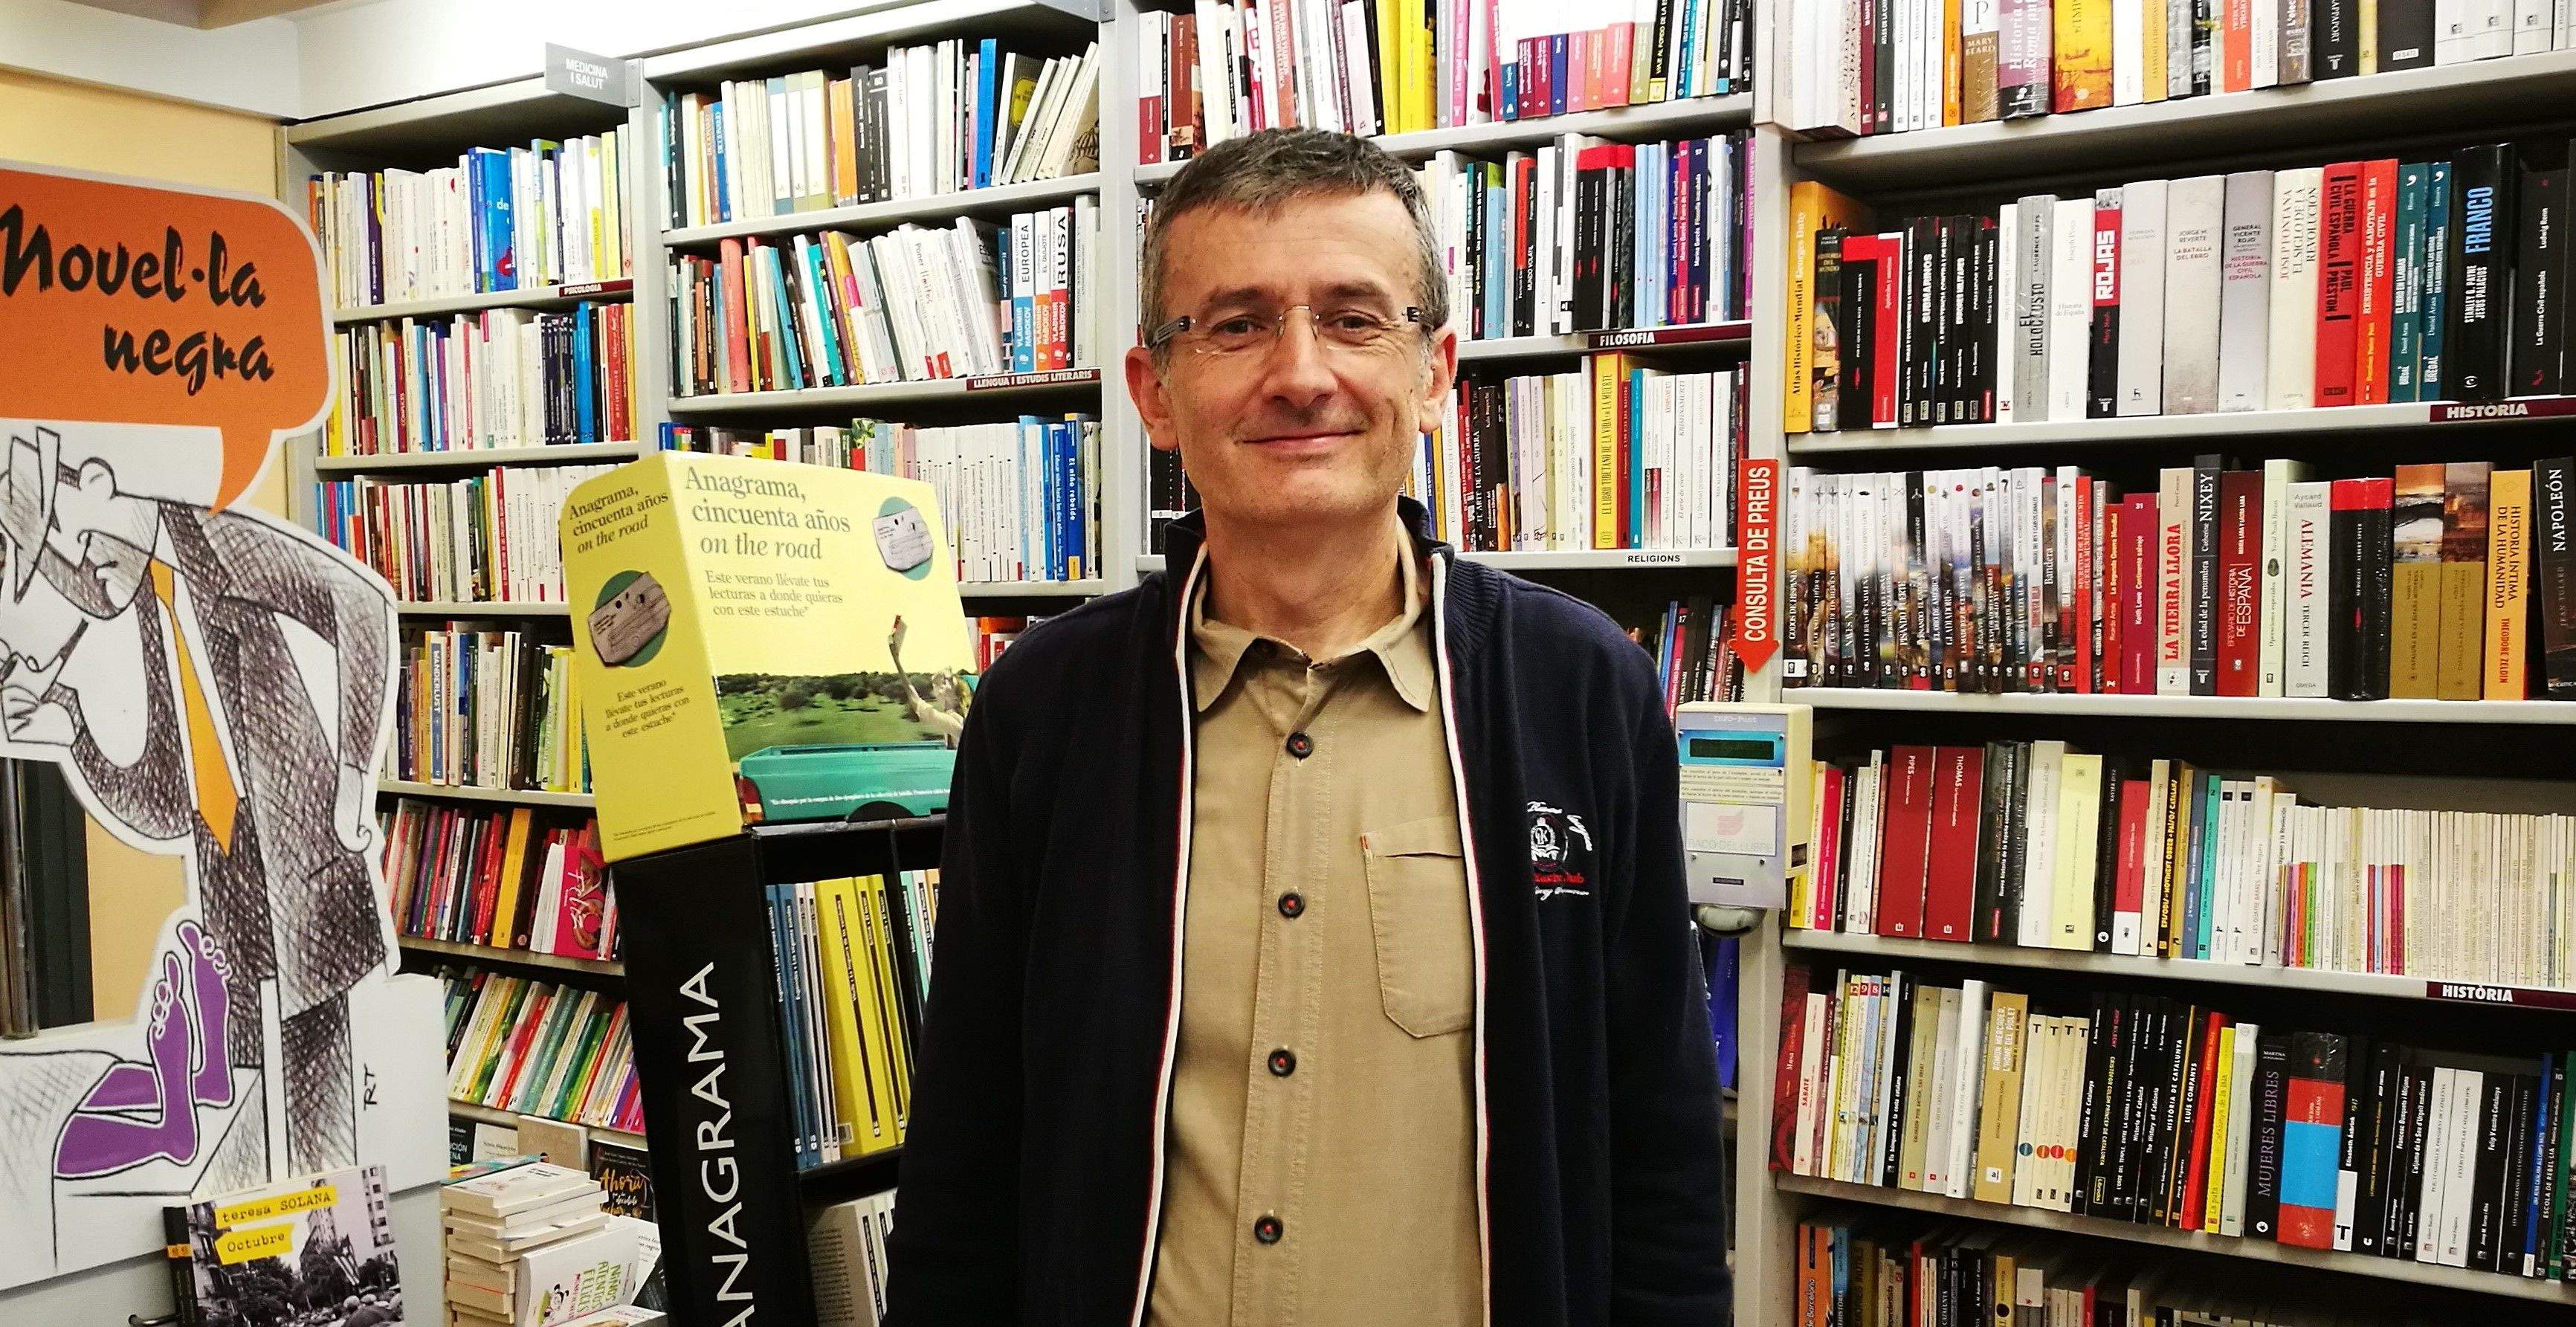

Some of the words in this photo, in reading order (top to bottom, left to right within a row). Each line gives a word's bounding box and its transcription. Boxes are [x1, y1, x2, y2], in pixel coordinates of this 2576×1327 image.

[1657, 48, 1663, 56] AL
[1661, 16, 1666, 25] DE
[566, 58, 608, 79] MEDICINA
[569, 71, 575, 83] I
[575, 74, 604, 89] SALUT
[2330, 184, 2342, 208] CIVIL
[2342, 184, 2355, 196] LA
[2281, 190, 2292, 245] FONTANA
[2305, 187, 2318, 262] REVOLUCIÓN
[2342, 198, 2354, 233] GUERRA
[2365, 199, 2377, 245] SABOTAJE
[2464, 187, 2493, 254] FRANCO
[2540, 207, 2548, 225] Renn
[1057, 216, 1066, 284] RUSA
[2293, 224, 2304, 259] SIGLO
[2538, 225, 2549, 249] Ludwig
[1021, 225, 1030, 282] EUROPEA
[2096, 230, 2115, 300] ROJAS
[2280, 247, 2291, 280] JOSEP
[1042, 264, 1047, 273] EL
[2341, 268, 2353, 291] PAUL
[2466, 265, 2478, 286] PAYNE
[2475, 266, 2487, 297] PALACIOS
[564, 283, 603, 296] PSICOLOGIA
[1923, 254, 1932, 323] SUBMARINOS
[2325, 270, 2337, 312] PRESTON
[2363, 256, 2375, 314] RESISTENCIA
[2537, 271, 2547, 298] española
[1795, 280, 1803, 323] Mundial
[2464, 295, 2476, 323] STANLEY
[2537, 300, 2546, 314] Civil
[2031, 282, 2045, 356] HOLOCAUSTO
[2536, 315, 2544, 337] Guerra
[1599, 332, 1655, 346] FILOSOFIA
[1793, 324, 1803, 369] Histórico
[103, 321, 274, 395] negra
[973, 377, 1010, 390] LLENGUA
[1016, 373, 1049, 387] ESTUDIS
[1050, 369, 1093, 384] LITERARIS
[1601, 374, 1613, 400] MUERTE
[1792, 370, 1801, 395] Atlas
[1601, 401, 1612, 410] LA
[1601, 418, 1612, 433] VIDA
[1601, 434, 1612, 443] LA
[1473, 430, 1481, 463] GUERRA
[1474, 465, 1481, 475] LA
[1474, 477, 1482, 488] DE
[1601, 454, 1612, 485] TIBETANO
[685, 467, 806, 502] Anagrama,
[1601, 487, 1612, 505] LIBRO
[1748, 465, 1772, 523] PREUS
[2200, 474, 2213, 522] NIXEY
[2294, 493, 2322, 503] Aycard
[569, 485, 639, 520] Anagrama,
[572, 507, 634, 536] cincuenta
[637, 491, 668, 511] años
[692, 498, 798, 528] cincuenta
[805, 509, 850, 532] años
[2497, 506, 2507, 520] DE
[2545, 469, 2566, 552] NAPOLEÓN
[577, 539, 593, 554] on
[596, 527, 615, 547] the
[619, 514, 648, 540] road
[1747, 526, 1770, 551] DE
[2201, 523, 2210, 552] Catherine
[2496, 522, 2506, 535] LA
[2509, 506, 2521, 558] HISTORIA
[701, 537, 728, 555] on
[735, 534, 768, 555] the
[775, 537, 822, 559] road
[1627, 554, 1681, 564] RELIGIONS
[2166, 523, 2180, 575] LLORA
[2300, 520, 2314, 598] ALEMANIA
[706, 570, 731, 584] Este
[735, 573, 773, 585] verano
[776, 572, 810, 586] llévate
[813, 576, 829, 587] tus
[2044, 548, 2053, 584] Bandera
[2200, 561, 2210, 599] penumbra
[2495, 537, 2506, 609] HUMANIDAD
[2508, 562, 2519, 600] ÍNTIMA
[708, 587, 756, 600] lecturas
[769, 590, 803, 602] donde
[806, 591, 843, 604] quieras
[1744, 555, 1769, 642] CONSULTA
[1789, 603, 1797, 613] DE
[2165, 579, 2180, 636] TIERRA
[2235, 568, 2252, 624] ESPAÑA
[713, 606, 735, 615] con
[738, 606, 762, 616] este
[2199, 610, 2208, 619] de
[1789, 616, 1797, 639] GODOS
[2199, 620, 2208, 639] edad
[2237, 624, 2245, 637] DE
[2499, 618, 2509, 655] THEODORE
[2165, 639, 2179, 660] LA
[2198, 640, 2207, 650] La
[2499, 658, 2508, 683] ZELDIN
[1908, 755, 1916, 774] PIPES
[1954, 755, 1964, 787] THOMAS
[2441, 985, 2514, 1002] HISTÒRIA
[1786, 1053, 1794, 1071] Musa
[2171, 1039, 2183, 1081] CATALUNYA
[1801, 1077, 1810, 1106] SABATÉ
[2169, 1085, 2178, 1093] DE
[2186, 1062, 2197, 1102] COMPANYS
[2262, 1071, 2279, 1122] LIBRES
[2166, 1097, 2177, 1131] HISTÒRIA
[2183, 1105, 2193, 1123] LLUÍS
[2257, 1127, 2273, 1197] MUJERES
[2346, 1140, 2354, 1166] Elisabeth
[223, 1207, 271, 1222] teresa
[280, 1192, 332, 1211] SOLANA
[2543, 1192, 2552, 1218] ESCOLA
[227, 1232, 285, 1253] Octubre
